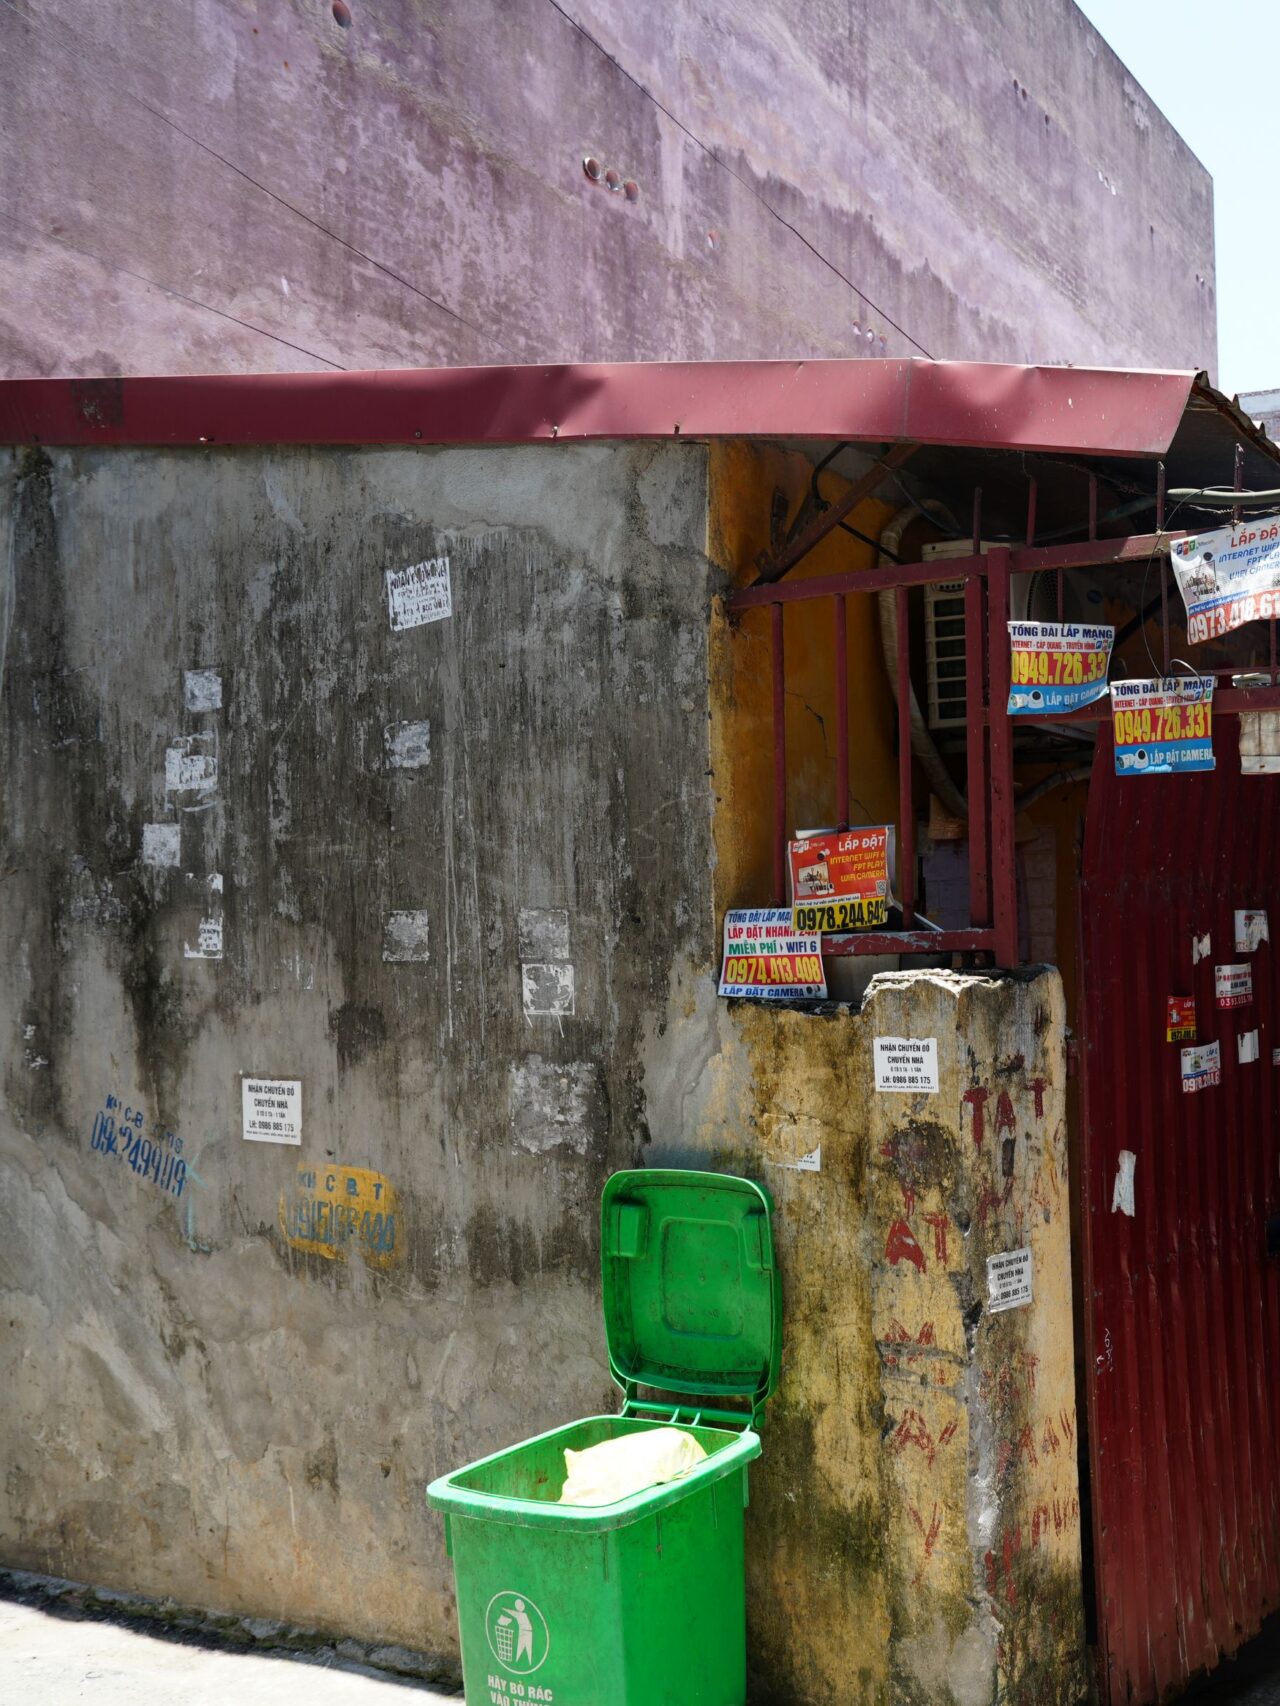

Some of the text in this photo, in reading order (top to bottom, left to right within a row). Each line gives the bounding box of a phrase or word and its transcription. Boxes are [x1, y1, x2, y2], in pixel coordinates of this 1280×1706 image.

[1231, 528, 1256, 548] LẮP
[1219, 546, 1259, 563] INTERNET
[1247, 556, 1261, 566] FPT
[1012, 624, 1112, 640] TỔNG ĐÀI LẮP MẠNG
[1115, 683, 1139, 695] TỔNG
[1143, 683, 1159, 694] ĐÀI
[1184, 679, 1212, 692] MẠNG
[1046, 691, 1062, 705] LẮP
[1115, 703, 1212, 744] 0949.726.331
[1150, 749, 1164, 764] LẮP
[839, 834, 885, 851] LẮP ĐẶT
[830, 852, 880, 864] INTERNET WIFI
[853, 860, 884, 871] FPT PLAY
[855, 869, 885, 880] CAMERA
[729, 911, 746, 923] TỔNG
[762, 910, 776, 922] LẮP
[728, 924, 795, 940] LẮP ĐẶT NHANH
[729, 940, 817, 955] MIỄN PHÍ WIFI 6
[726, 956, 821, 983] 0974.413.408
[724, 986, 804, 997] LẮP ĐẶT CAMERA
[880, 1043, 896, 1053] NHẬN
[898, 1042, 921, 1052] CHUYỂN
[888, 1054, 923, 1064] CHUYỂN NHÀ
[908, 1076, 919, 1084] 885
[920, 1076, 931, 1084] 175
[284, 1123, 294, 1132] 175
[488, 1675, 552, 1701] HÃY BỎ RÁC
